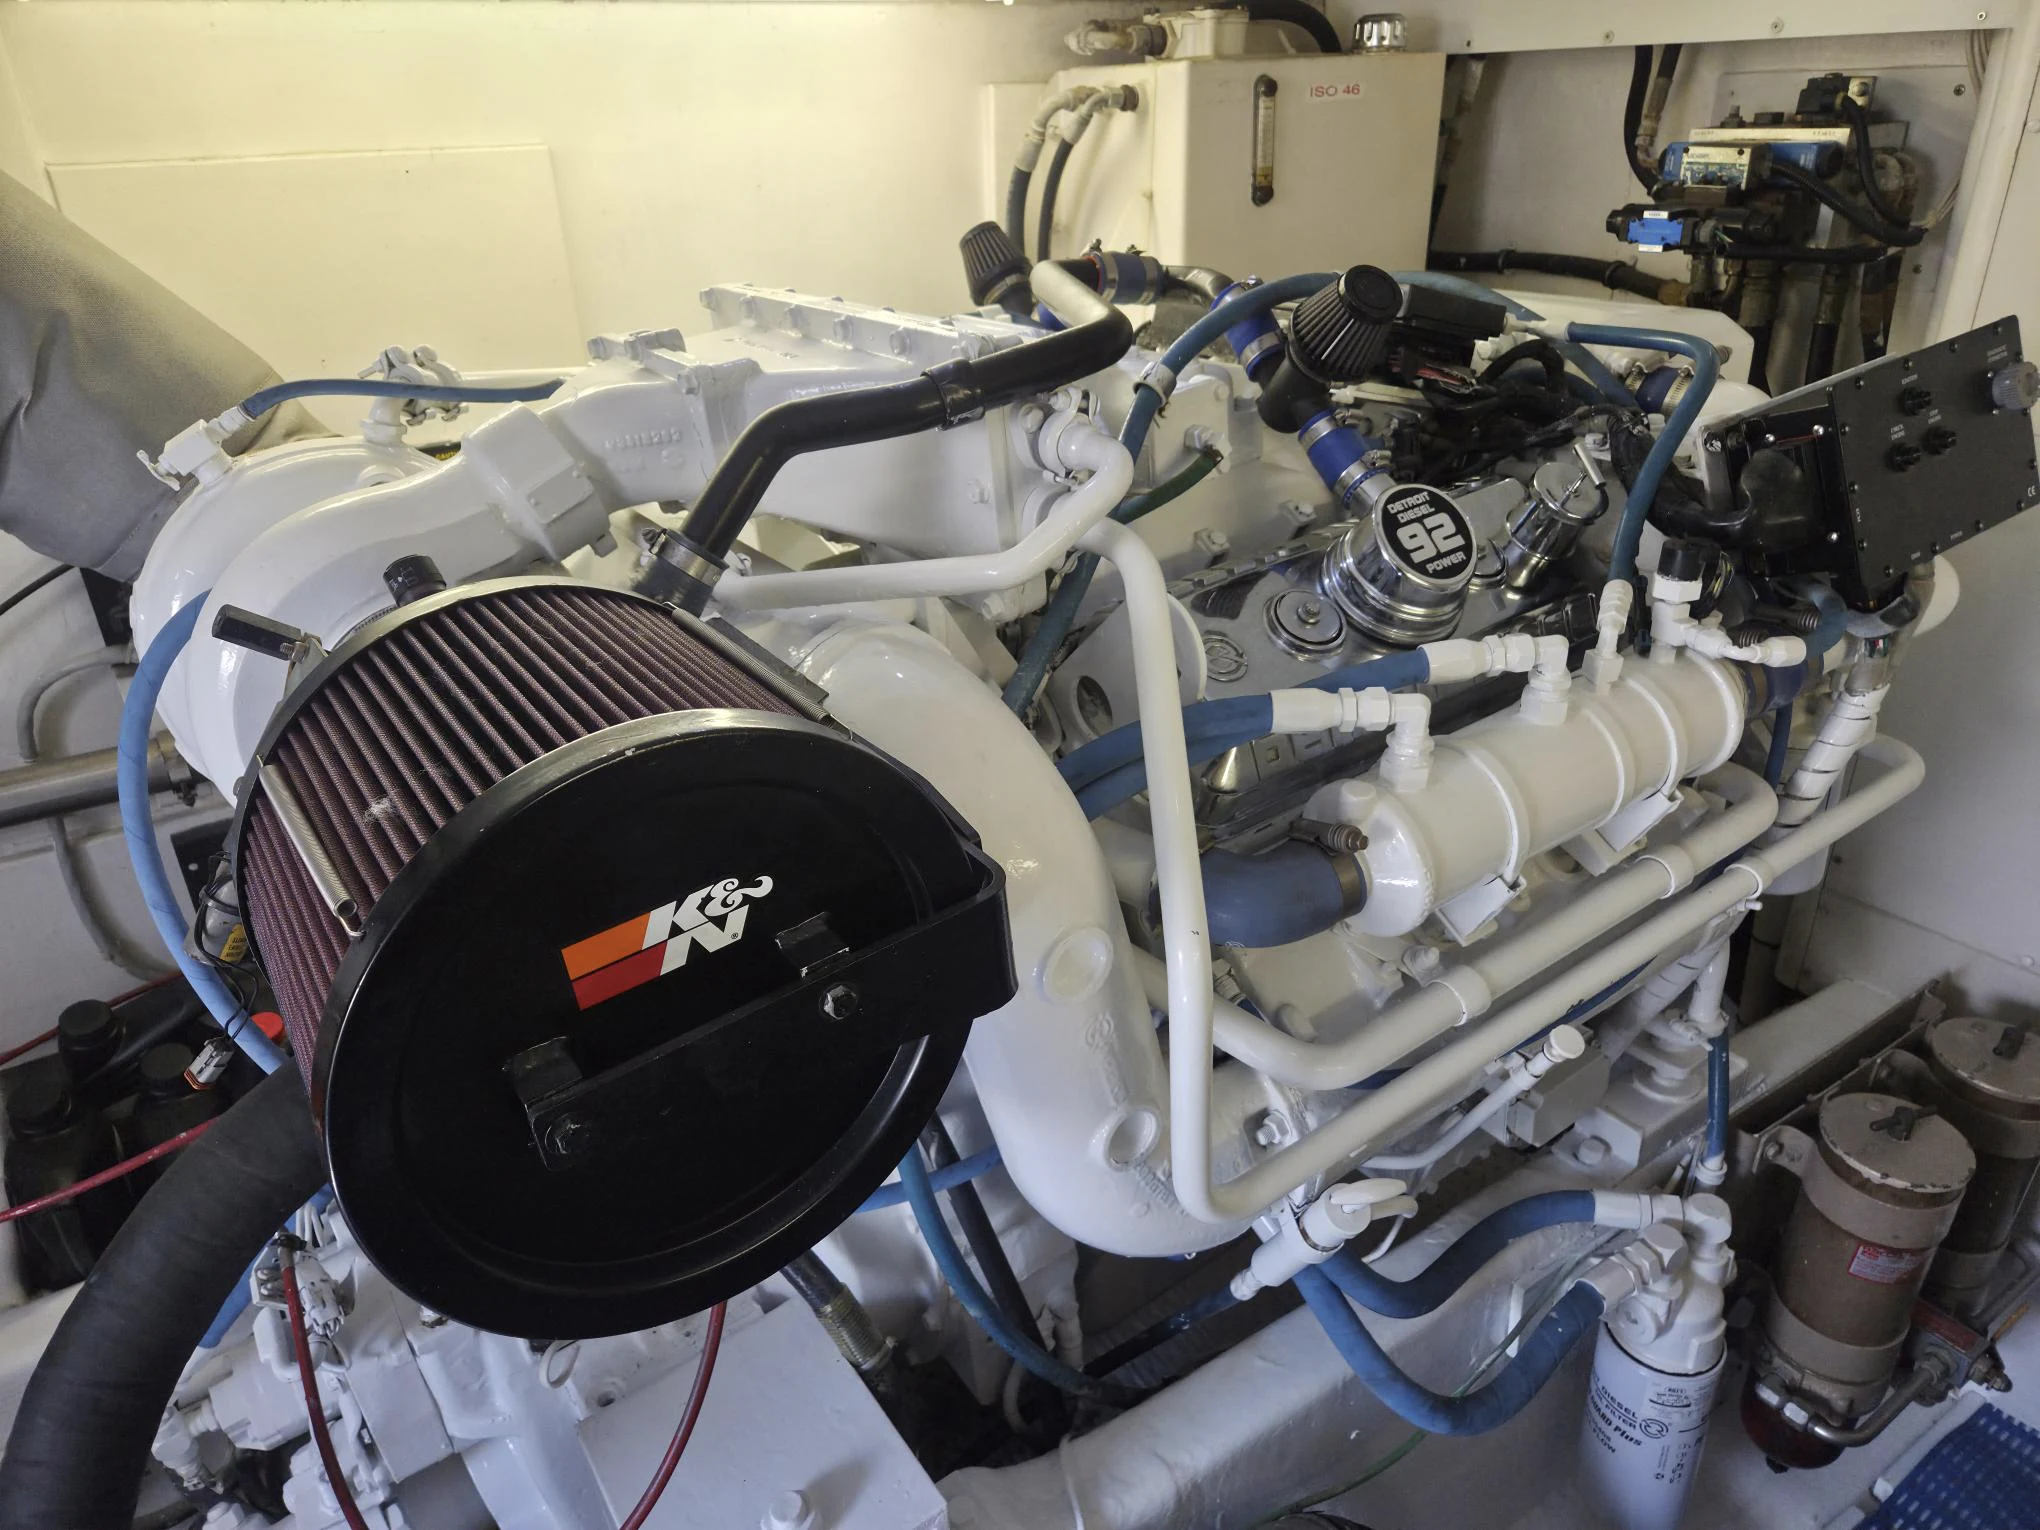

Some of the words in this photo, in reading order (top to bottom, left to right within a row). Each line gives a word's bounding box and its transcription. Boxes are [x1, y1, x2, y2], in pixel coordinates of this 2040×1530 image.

[1309, 85, 1338, 98] ISO
[1342, 84, 1361, 96] 46
[1387, 491, 1430, 514] DETROIT
[1396, 503, 1435, 523] DIESEL
[1396, 512, 1466, 564] 92
[1425, 551, 1467, 574] POWER
[1601, 1385, 1638, 1420] DIESEL
[1605, 1403, 1637, 1430] FILTER
